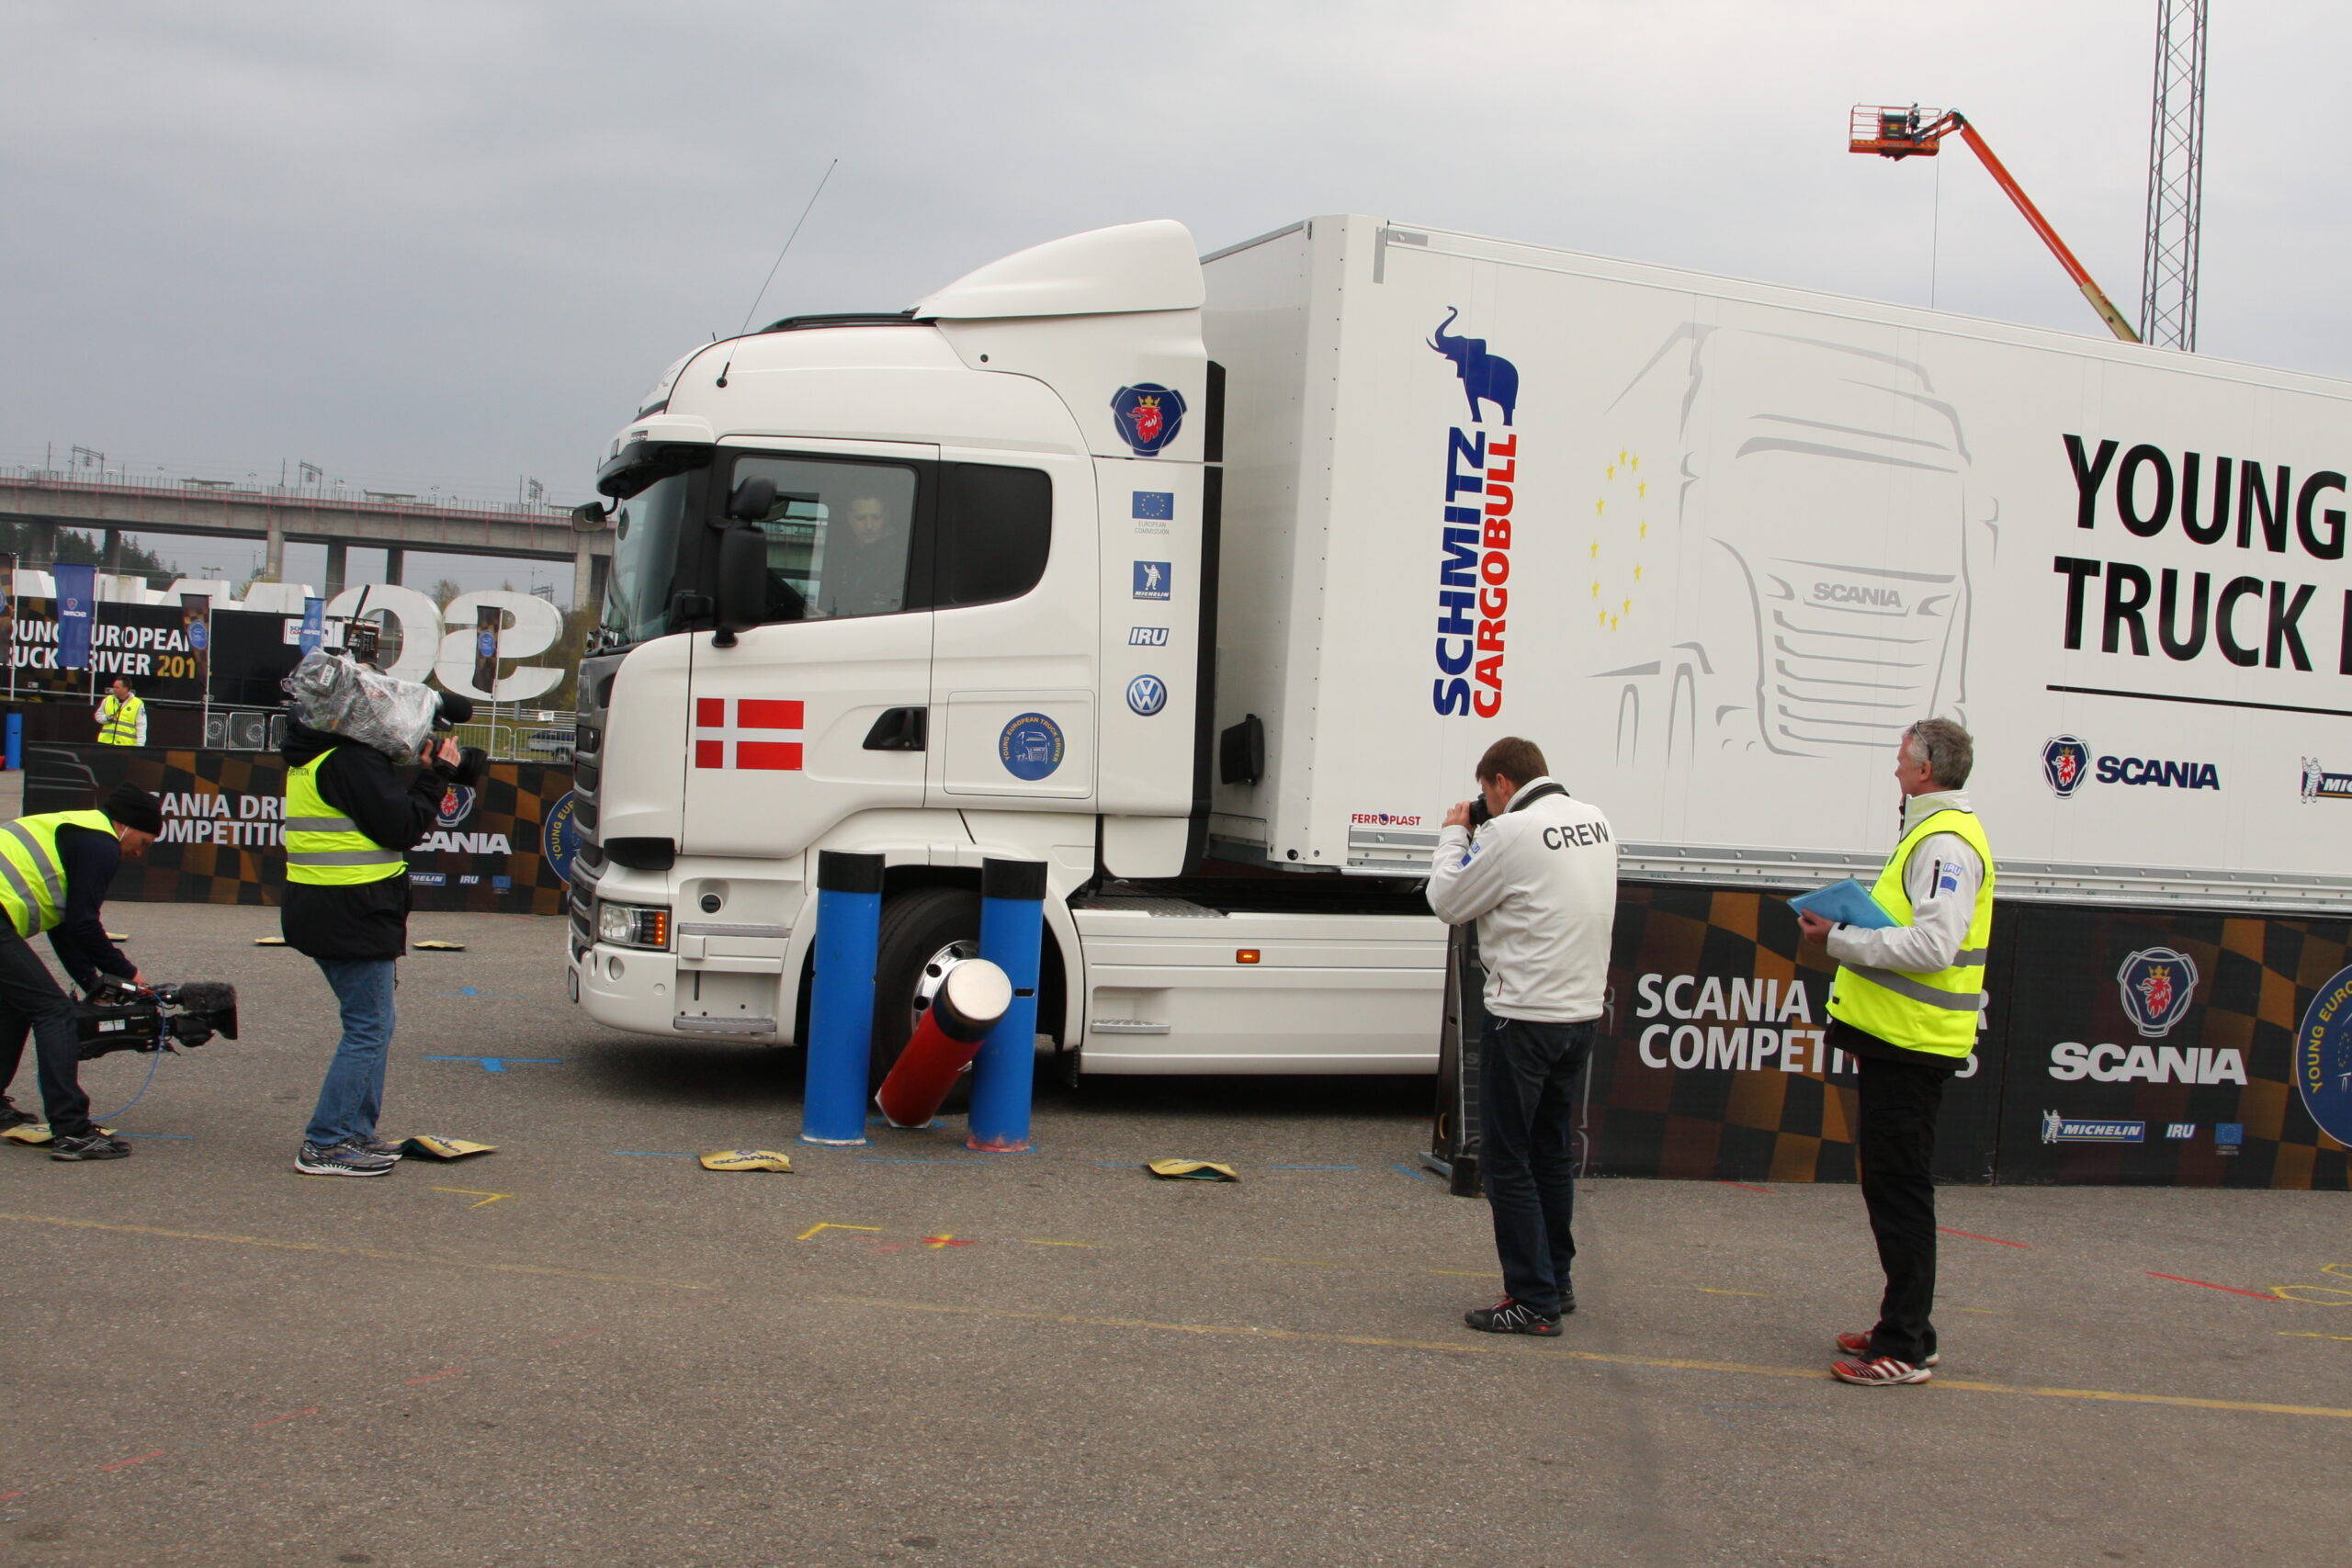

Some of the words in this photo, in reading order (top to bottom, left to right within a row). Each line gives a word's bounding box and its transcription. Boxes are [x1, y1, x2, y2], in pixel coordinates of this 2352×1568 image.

[2062, 434, 2347, 560] YOUNG
[1138, 521, 1166, 529] EUROPEAN
[1432, 426, 1486, 716] SCHMITZ
[1473, 434, 1517, 718] CARGOBULL
[1813, 581, 1903, 609] SCANIA
[2054, 556, 2317, 672] TRUCK
[90, 624, 189, 652] UROPEA
[1130, 628, 1168, 645] IRU
[157, 655, 196, 679] 201
[2096, 755, 2221, 790] SCANIA
[551, 821, 563, 861] YOUNG
[1543, 821, 1610, 851] CREW
[459, 874, 479, 885] IRU
[1636, 973, 1811, 1023] SCANIA
[2049, 1042, 2247, 1086] SCANIA
[2308, 1024, 2325, 1094] YOUNG
[2063, 1123, 2141, 1136] MICHELIN
[2166, 1123, 2196, 1139] IRU
